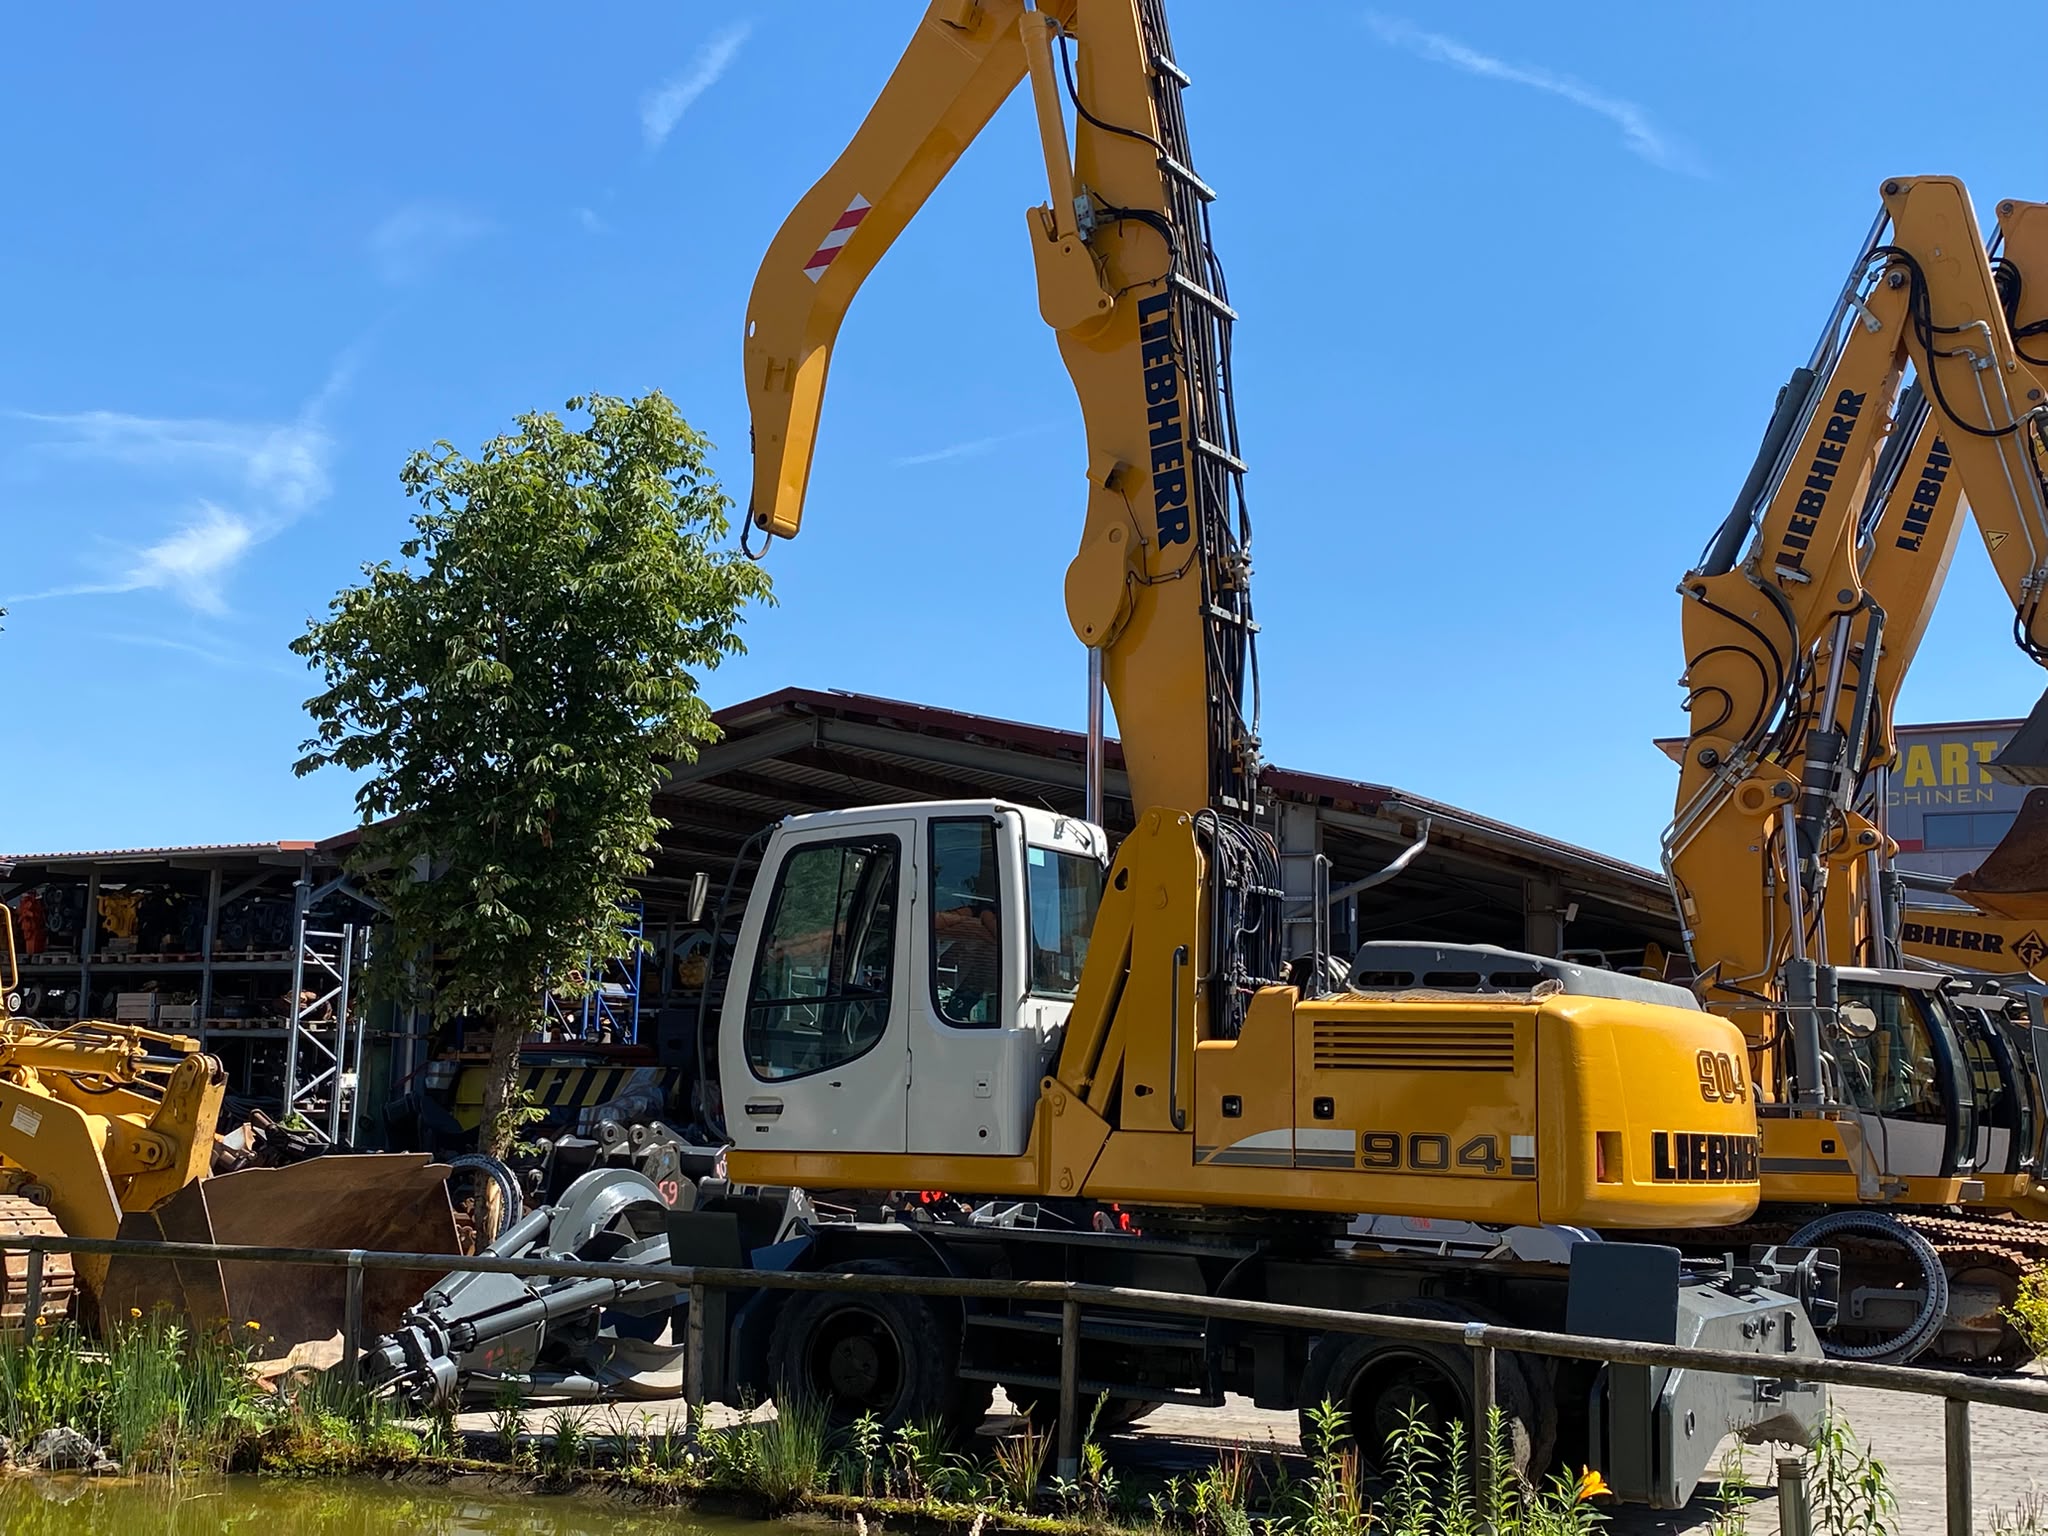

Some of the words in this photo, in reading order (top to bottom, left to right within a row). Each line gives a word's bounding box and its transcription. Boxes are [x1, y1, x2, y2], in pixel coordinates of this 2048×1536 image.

[1137, 291, 1191, 551] LIEBHERR
[1775, 389, 1868, 568] LIEBHERR
[1895, 430, 1952, 552] LIEBHE
[1891, 741, 1998, 788] ART
[1866, 788, 1993, 807] CHINEN
[1902, 923, 2004, 954] BHERR
[1697, 1049, 1746, 1104] 904
[1361, 1130, 1504, 1174] 904
